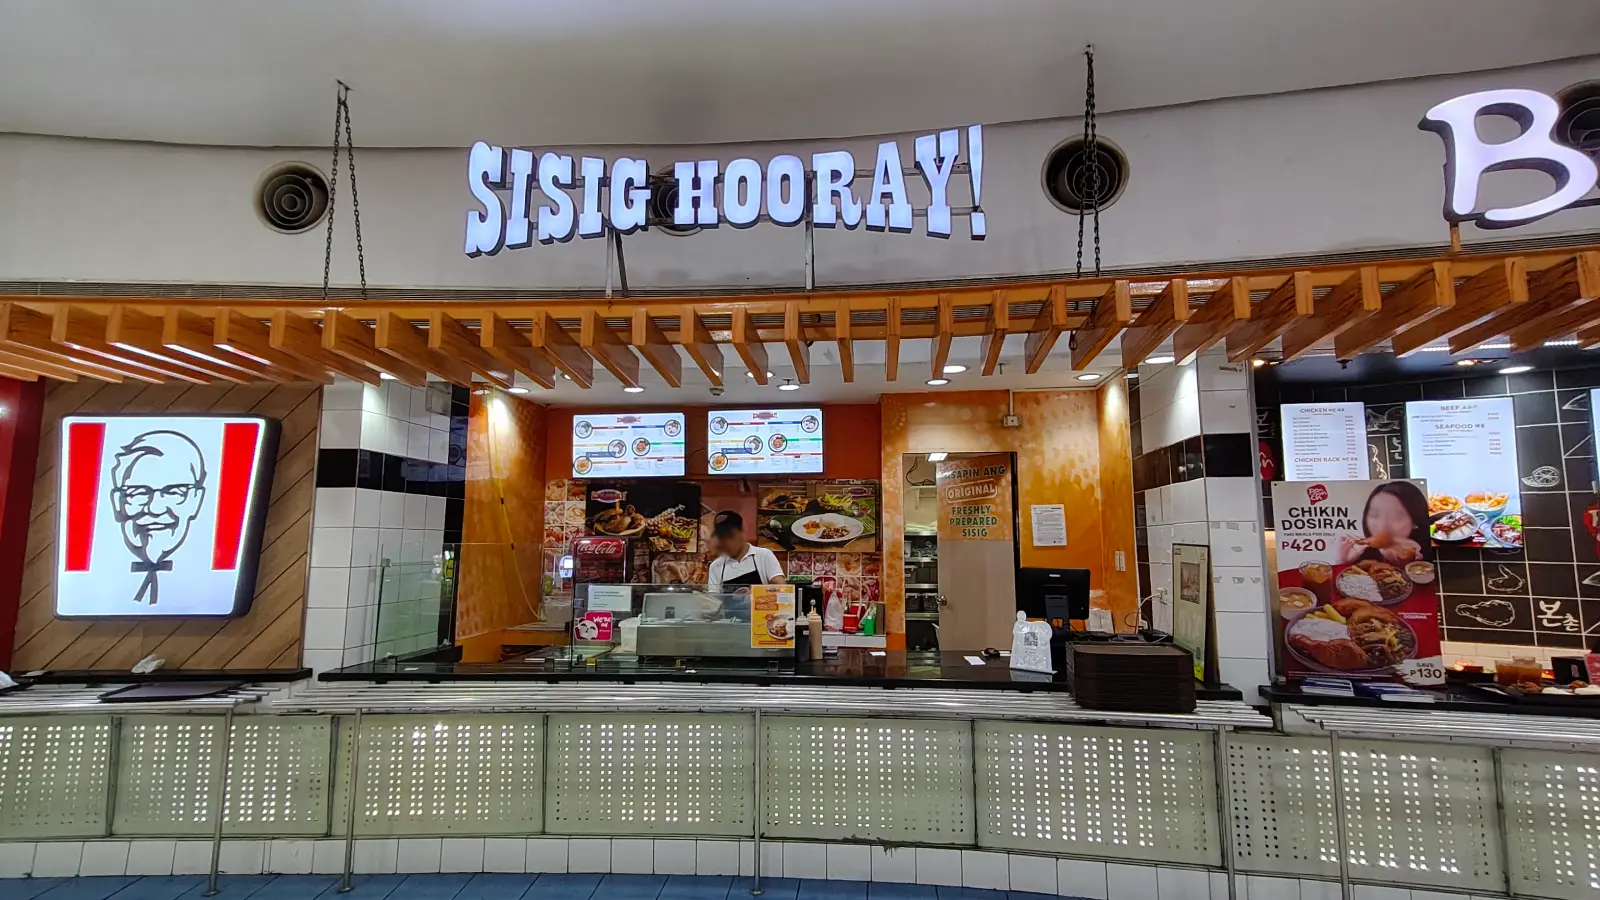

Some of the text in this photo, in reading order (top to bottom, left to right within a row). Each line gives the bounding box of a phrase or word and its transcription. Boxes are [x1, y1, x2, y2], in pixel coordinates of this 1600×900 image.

[465, 124, 987, 257] SISIG HOORAY!
[983, 465, 1006, 476] ANG
[947, 484, 996, 499] ORIGINAL
[951, 504, 991, 516] FRESHLY
[1288, 506, 1349, 518] CHIKIN
[949, 516, 998, 526] PREPARED
[1281, 518, 1358, 531] DOSIRAK
[962, 528, 988, 537] SISIG
[577, 541, 618, 554] Coca-Cola
[1281, 538, 1327, 552] P420
[1410, 668, 1443, 679] P130
